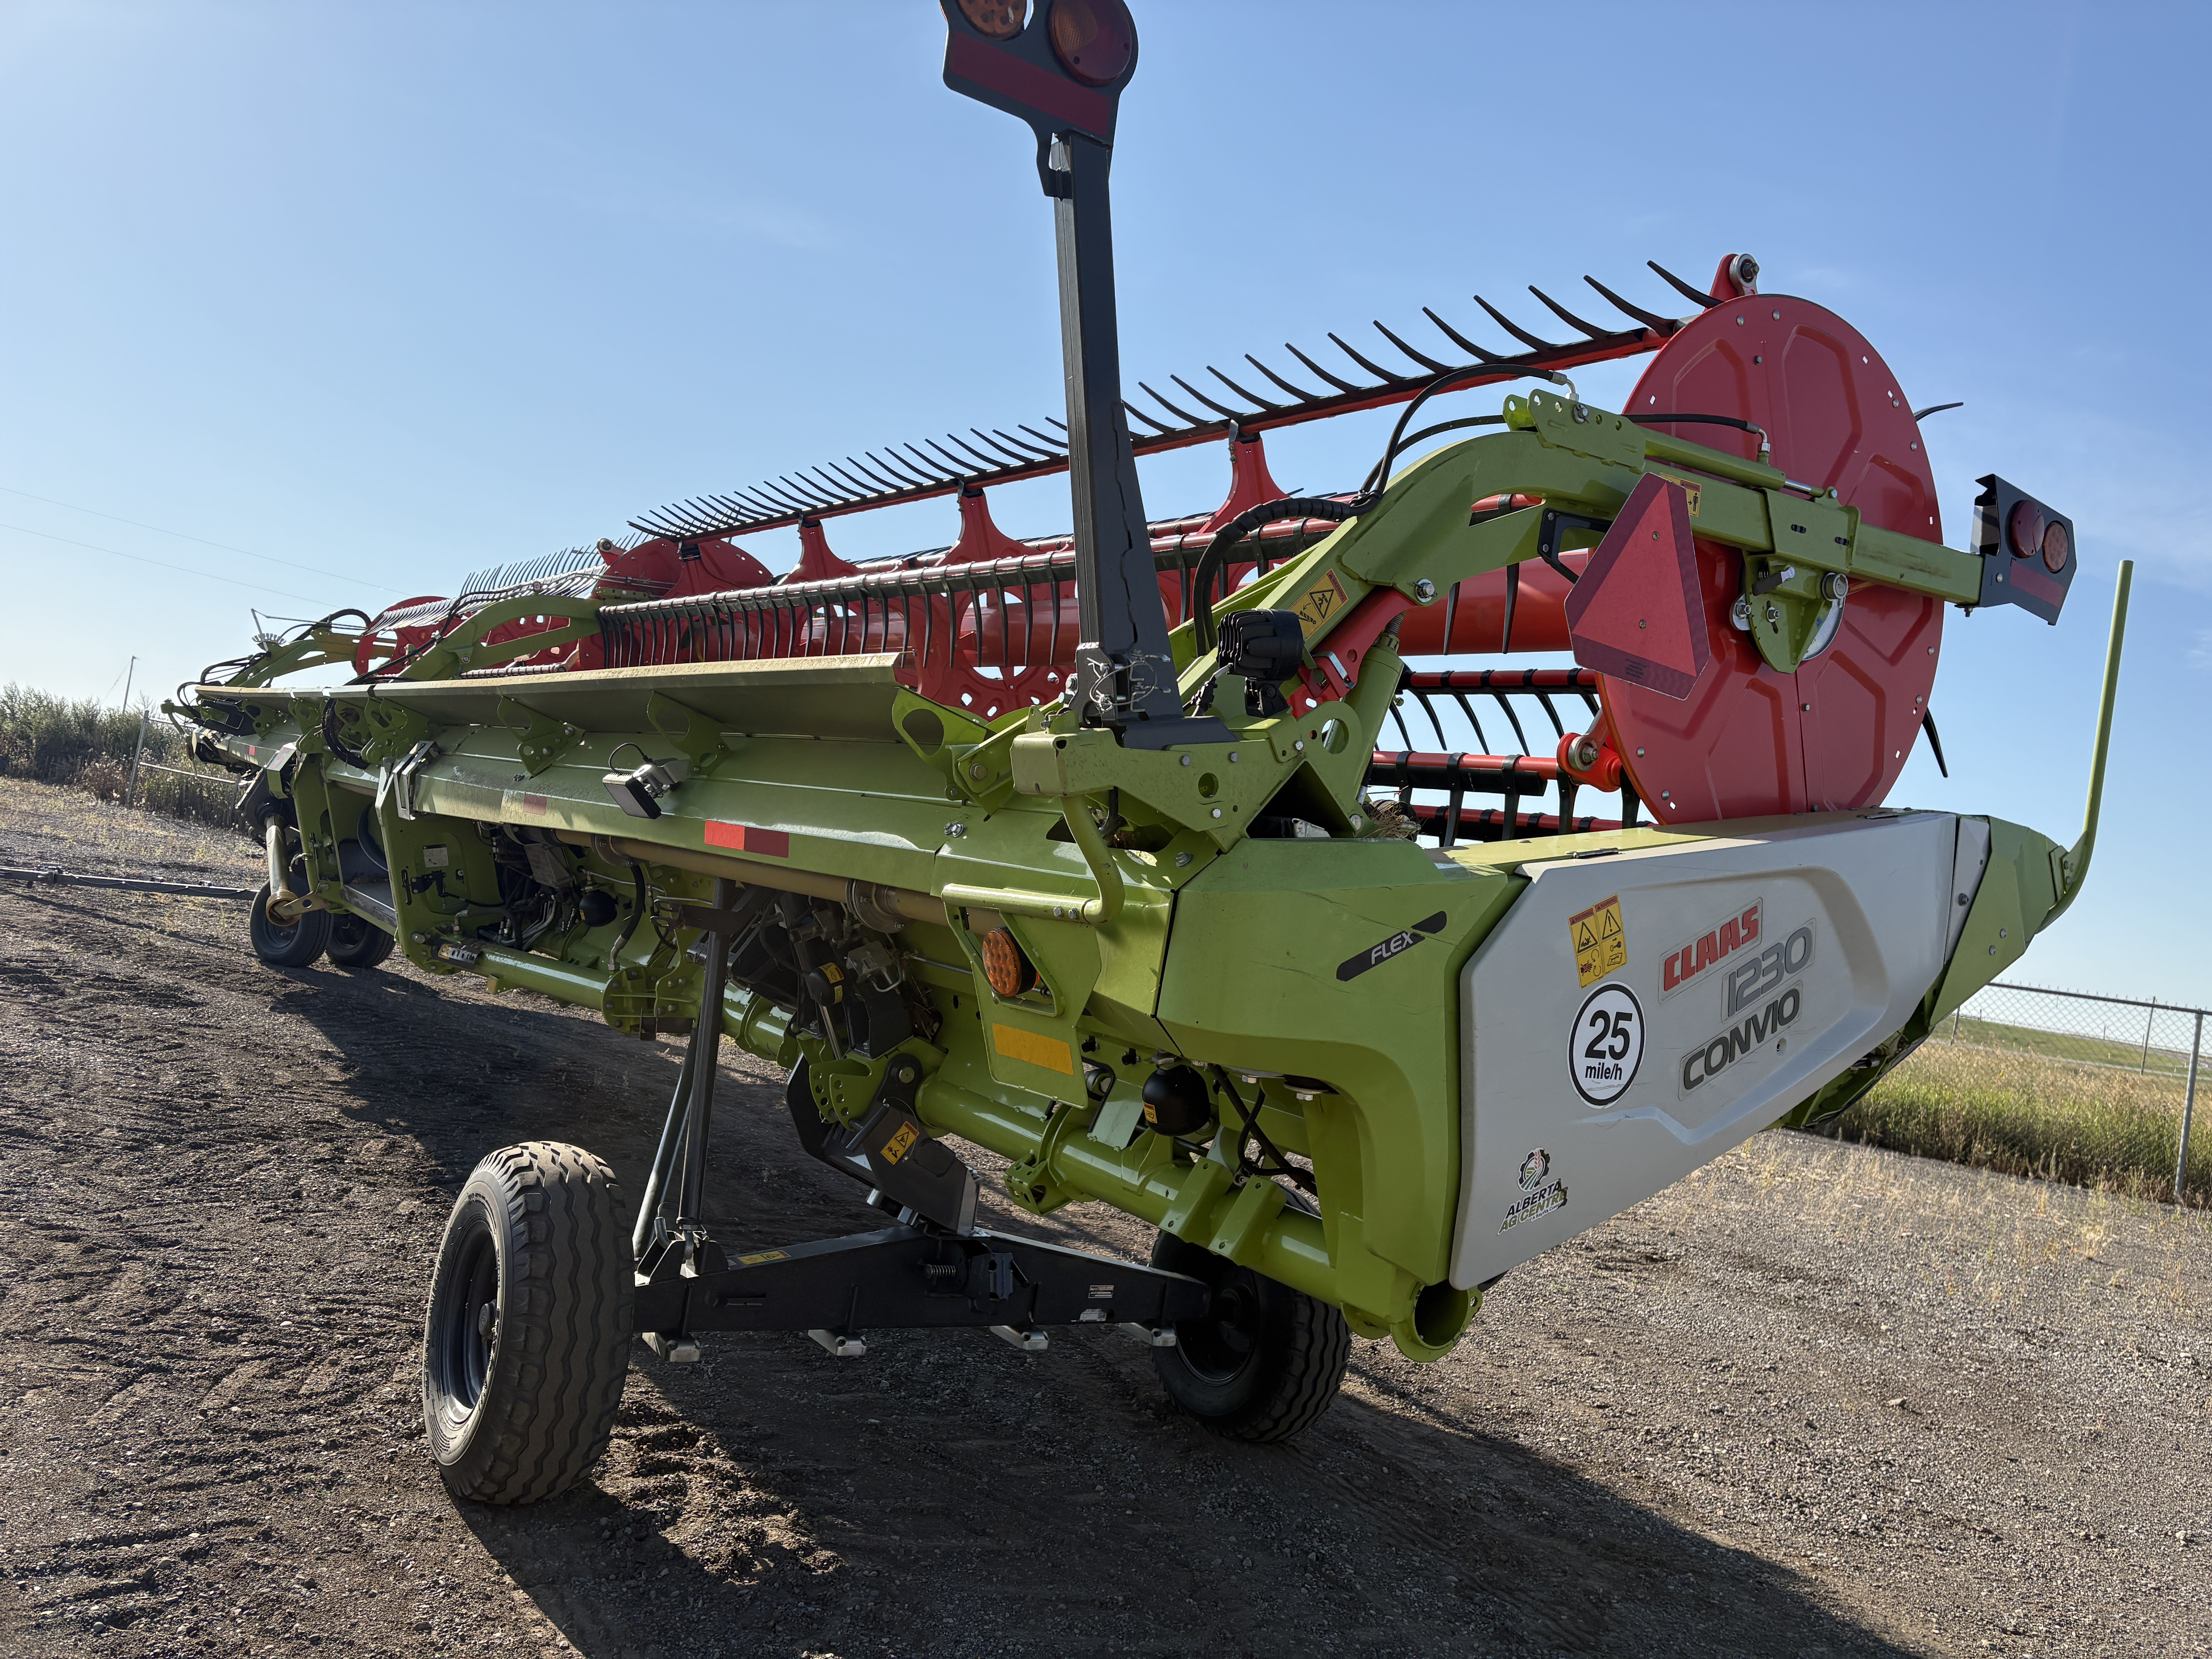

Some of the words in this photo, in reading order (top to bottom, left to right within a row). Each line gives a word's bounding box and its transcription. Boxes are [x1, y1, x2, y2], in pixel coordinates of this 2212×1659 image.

[1575, 910, 1594, 921] WARNING
[1601, 897, 1617, 907] WARNING
[1371, 932, 1413, 965] FLEX
[1664, 905, 1759, 991] CLAAS
[1728, 927, 1813, 1017] 1230
[1585, 1010, 1633, 1060] 25
[1684, 988, 1800, 1090] CONVIO
[1585, 1062, 1622, 1080] mile/h
[1505, 1178, 1561, 1219] ALBERTA
[1498, 1215, 1518, 1234] AG
